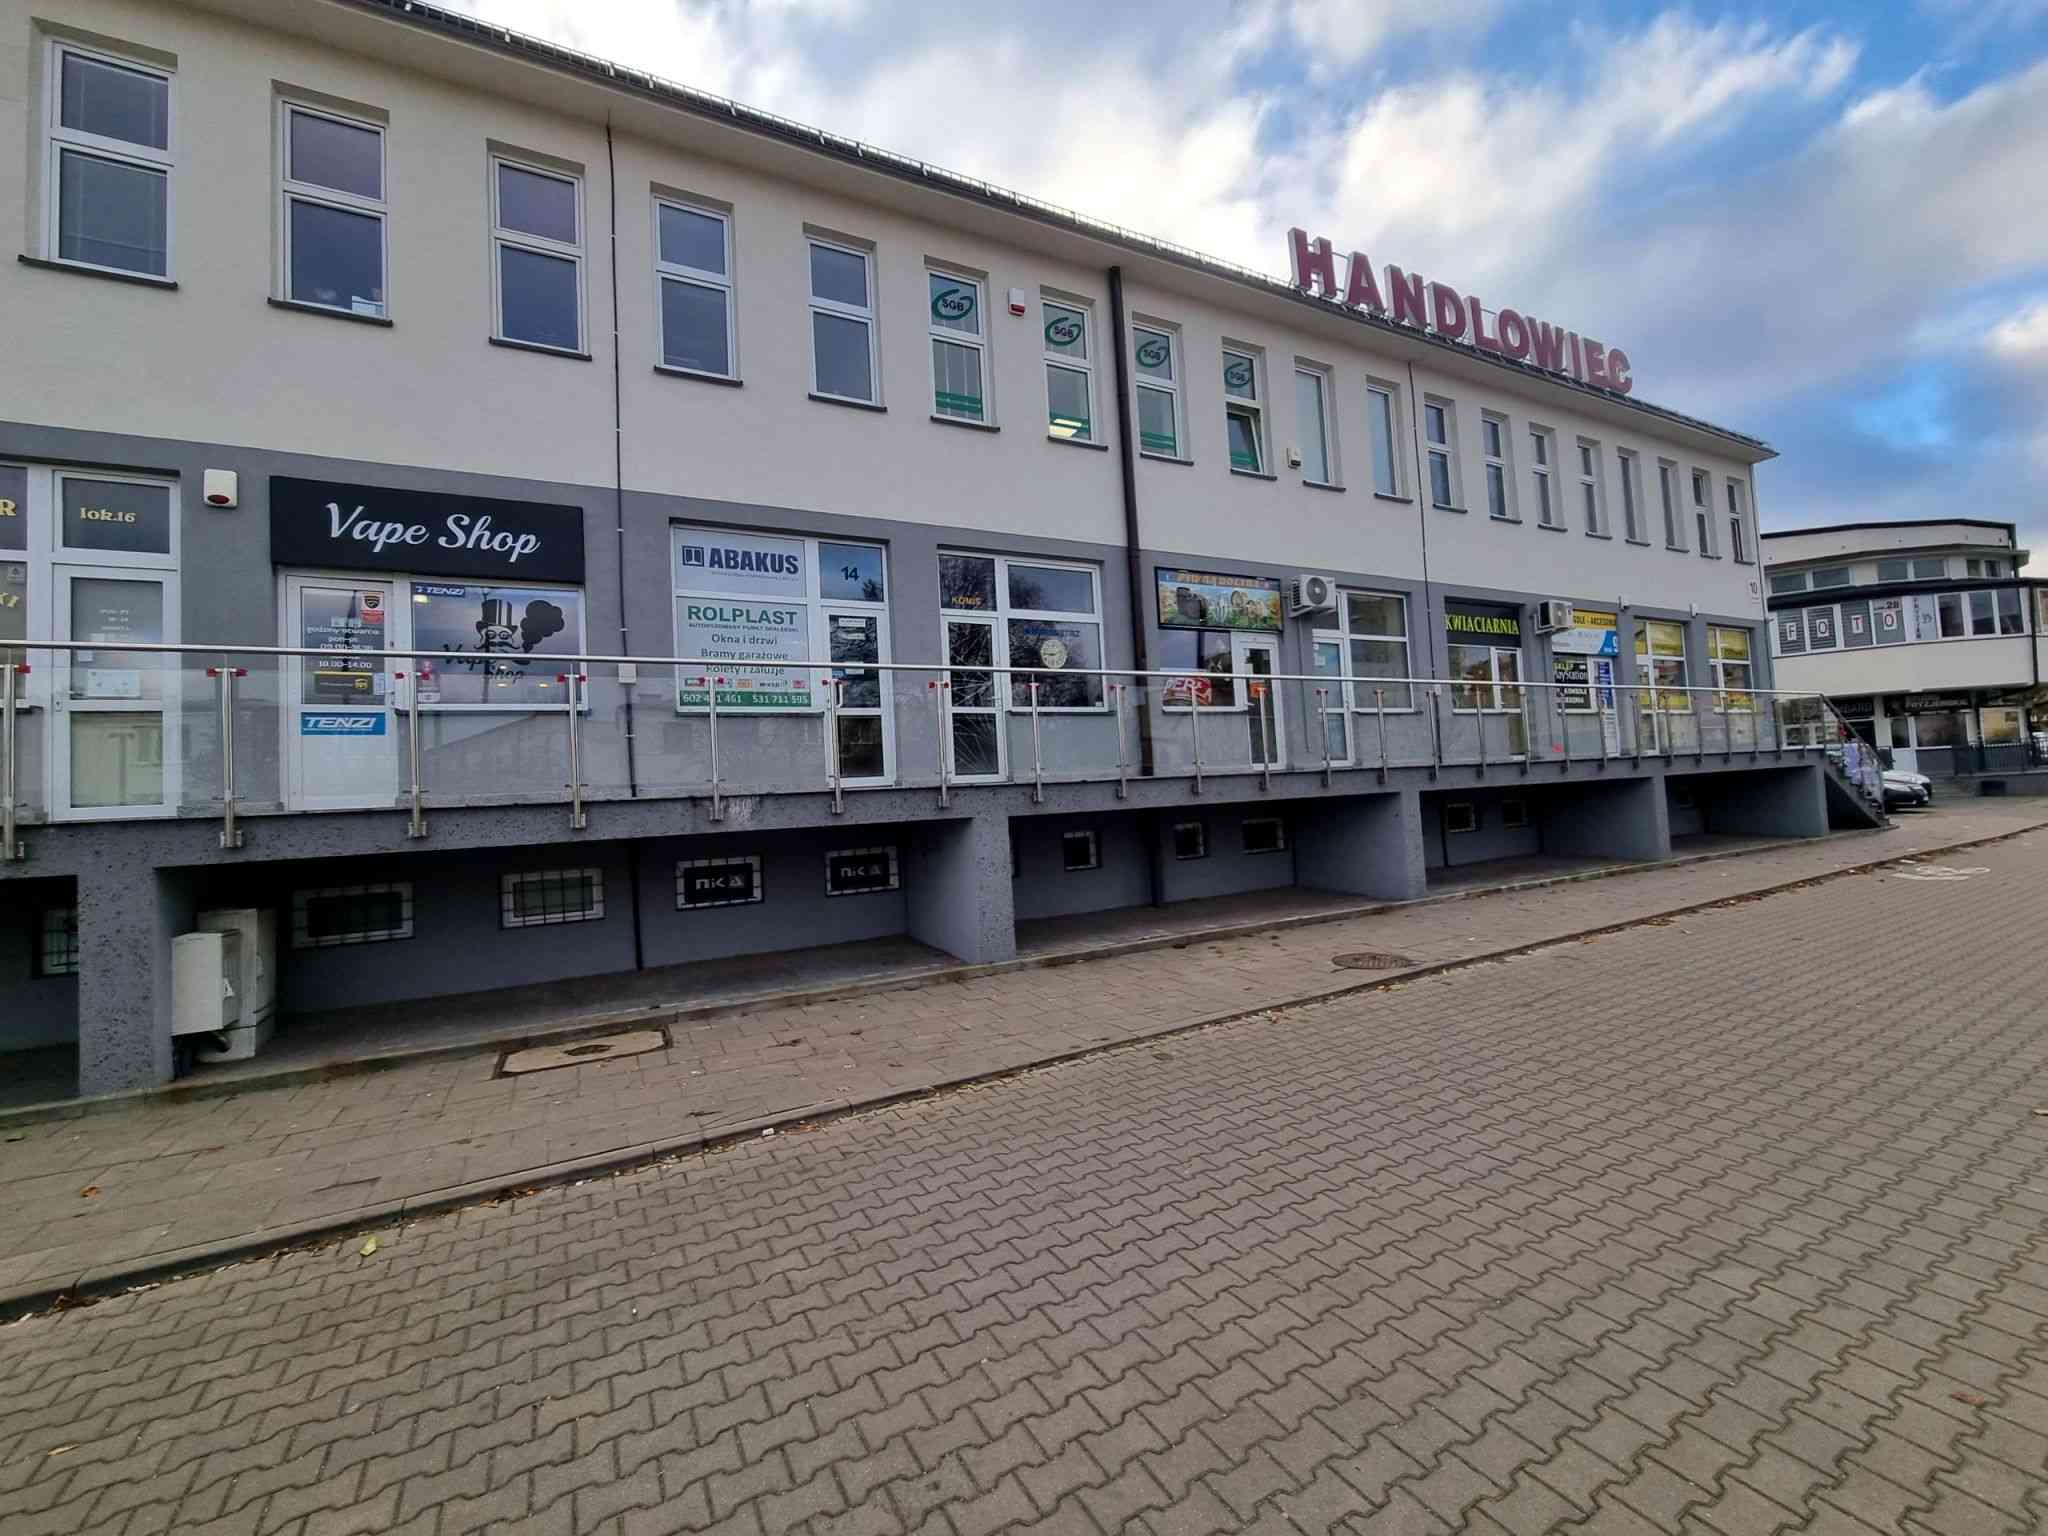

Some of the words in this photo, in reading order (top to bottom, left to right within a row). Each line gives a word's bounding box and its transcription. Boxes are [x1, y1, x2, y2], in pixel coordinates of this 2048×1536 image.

[1288, 227, 1633, 395] HANDLOWIEC
[325, 502, 430, 553] Vape
[438, 513, 542, 563] Shop
[709, 547, 800, 575] ABAKUS
[841, 566, 860, 581] 14
[1750, 581, 1758, 594] 10
[687, 605, 798, 625] ROLPLAST
[1445, 614, 1520, 635] KWIACIARNIA
[711, 633, 740, 644] Okna
[749, 635, 778, 645] drzwi
[700, 647, 737, 660] Bramy
[303, 716, 377, 729] TENZI
